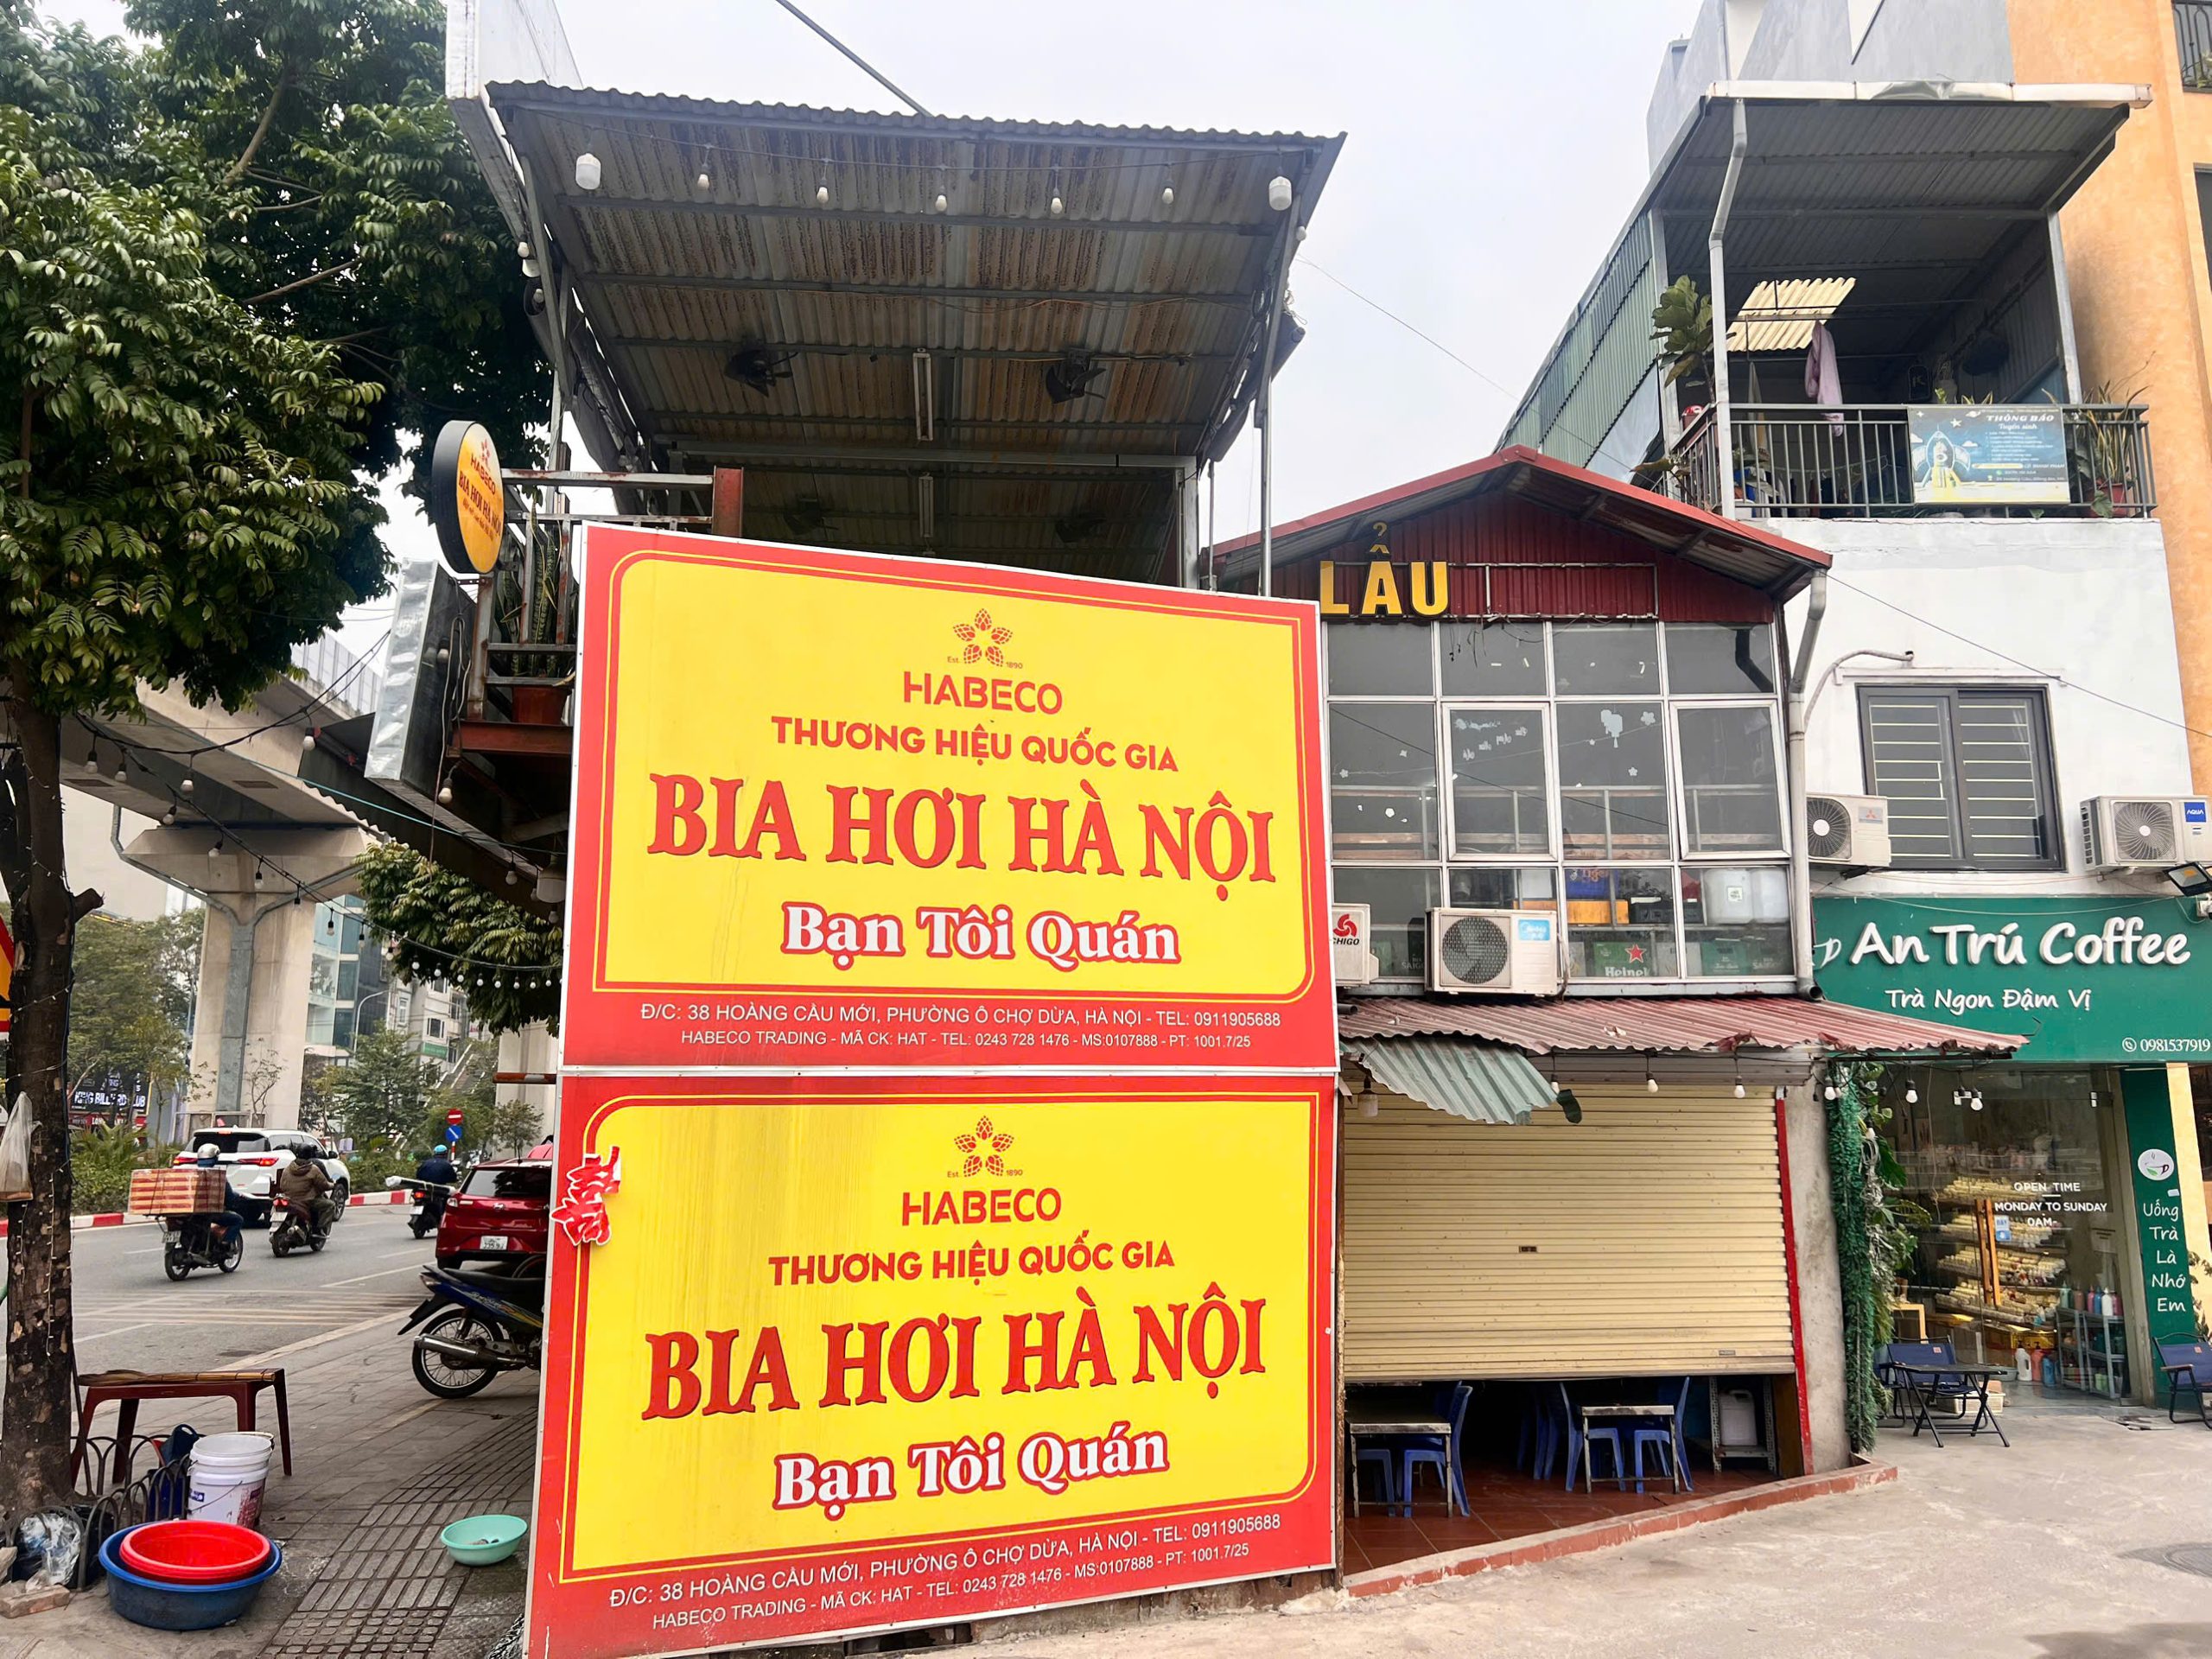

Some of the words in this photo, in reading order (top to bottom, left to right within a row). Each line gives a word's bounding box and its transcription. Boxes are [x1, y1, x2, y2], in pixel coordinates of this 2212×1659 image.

[1986, 413, 2028, 423] THÔNG
[2031, 413, 2055, 423] BÁO
[458, 470, 469, 496] BIA
[470, 453, 497, 495] HABECO
[1319, 521, 1449, 617] LẨU
[903, 671, 1063, 715] HABECO
[771, 715, 925, 753] THƯƠNG
[936, 723, 1012, 766] HIỆU
[1022, 727, 1116, 767] QUỐC
[1125, 743, 1179, 772] GIA
[647, 772, 807, 862] BIA
[825, 785, 987, 870] HƠI
[1007, 779, 1125, 877] HÀ
[1139, 791, 1276, 902] NỘI
[784, 905, 902, 968] Bạn
[919, 907, 1013, 957] Tôi
[1029, 912, 1179, 969] Quán
[1850, 922, 1929, 966] An
[1929, 922, 2027, 966] Trú
[2039, 916, 2191, 966] Coffee
[640, 1003, 681, 1020] Đ/C:
[688, 1004, 710, 1020] 38
[716, 1001, 788, 1021] HOÀNG
[793, 1002, 833, 1022] CẦU
[839, 1003, 880, 1024] MỚI,
[887, 1004, 969, 1023] PHƯỜNG
[975, 1005, 988, 1024] Ô
[993, 1008, 1033, 1027] CHỢ
[1038, 1006, 1080, 1027] DỪA,
[1085, 1007, 1109, 1025] HÀ
[1113, 1008, 1141, 1027] NỘI
[1155, 1010, 1189, 1026] TEL:
[1194, 1011, 1281, 1027] 0911905688
[1885, 988, 1925, 1009] Trà
[1934, 988, 1993, 1015] Ngon
[2001, 988, 2059, 1011] Đậm
[2069, 988, 2091, 1012] Vị
[681, 1030, 751, 1045] HABECO
[755, 1031, 827, 1045] TRADING
[841, 1029, 864, 1045] MÃ
[868, 1032, 893, 1046] CK:
[898, 1032, 927, 1045] HAT
[940, 1033, 970, 1046] TEL:
[975, 1033, 1007, 1046] 0243
[1011, 1033, 1035, 1046] 728
[1039, 1033, 1070, 1046] 1476
[1082, 1033, 1158, 1047] MS:0107888
[1169, 1034, 1190, 1047] PT:
[1194, 1034, 1251, 1047] 1001.7/25
[2140, 1039, 2210, 1052] 0981537919
[94, 1092, 127, 1106] BILLRD
[128, 1095, 146, 1107] LUB
[2013, 1182, 2047, 1192] OPEN
[2053, 1182, 2081, 1192] TIME
[901, 1187, 1062, 1226] HABECO
[1994, 1202, 2043, 1211] MONDAY
[2044, 1202, 2061, 1211] TO
[2063, 1202, 2107, 1212] SUNDAY
[2143, 1198, 2179, 1222] Uống
[2149, 1225, 2179, 1241] Trà
[768, 1251, 923, 1287] THƯƠNG
[933, 1240, 1009, 1286] HIỆU
[1019, 1230, 1114, 1276] QUỐC
[1122, 1240, 1175, 1269] GIA
[2157, 1249, 2177, 1265] Là
[2152, 1272, 2186, 1288] Nhớ
[2157, 1298, 2186, 1313] Em
[642, 1326, 801, 1421] BIA
[818, 1313, 982, 1408] HƠI
[1001, 1287, 1117, 1395] HÀ
[1133, 1282, 1267, 1400] NỘI
[776, 1455, 893, 1518] Bạn
[911, 1434, 1003, 1496] Tôi
[1020, 1422, 1167, 1492] Quán
[609, 1586, 653, 1607] Đ/C:
[659, 1582, 683, 1602] 38
[690, 1573, 766, 1599] HOÀNG
[772, 1566, 814, 1589] CẦU
[820, 1560, 863, 1584] MỚI,
[870, 1553, 957, 1579] PHƯỜNG
[963, 1548, 977, 1568] Ô
[982, 1545, 1025, 1566] CHỢ
[1029, 1538, 1073, 1561] DỪA,
[1079, 1532, 1103, 1554] HÀ
[1108, 1530, 1137, 1551] NỘI
[1153, 1525, 1187, 1543] TEL:
[1192, 1513, 1281, 1540] 0911905688
[652, 1606, 726, 1630] HABECO
[730, 1598, 806, 1620] TRADING
[821, 1591, 846, 1611] MÃ
[849, 1590, 877, 1606] CK:
[880, 1586, 913, 1603] HAT
[925, 1581, 957, 1598] TEL:
[963, 1575, 997, 1594] 0243
[1001, 1572, 1027, 1588] 728
[1030, 1567, 1062, 1585] 1476
[1074, 1554, 1154, 1579] MS:0107888
[1166, 1549, 1186, 1566] PT:
[1192, 1542, 1249, 1562] 1001.7/25
